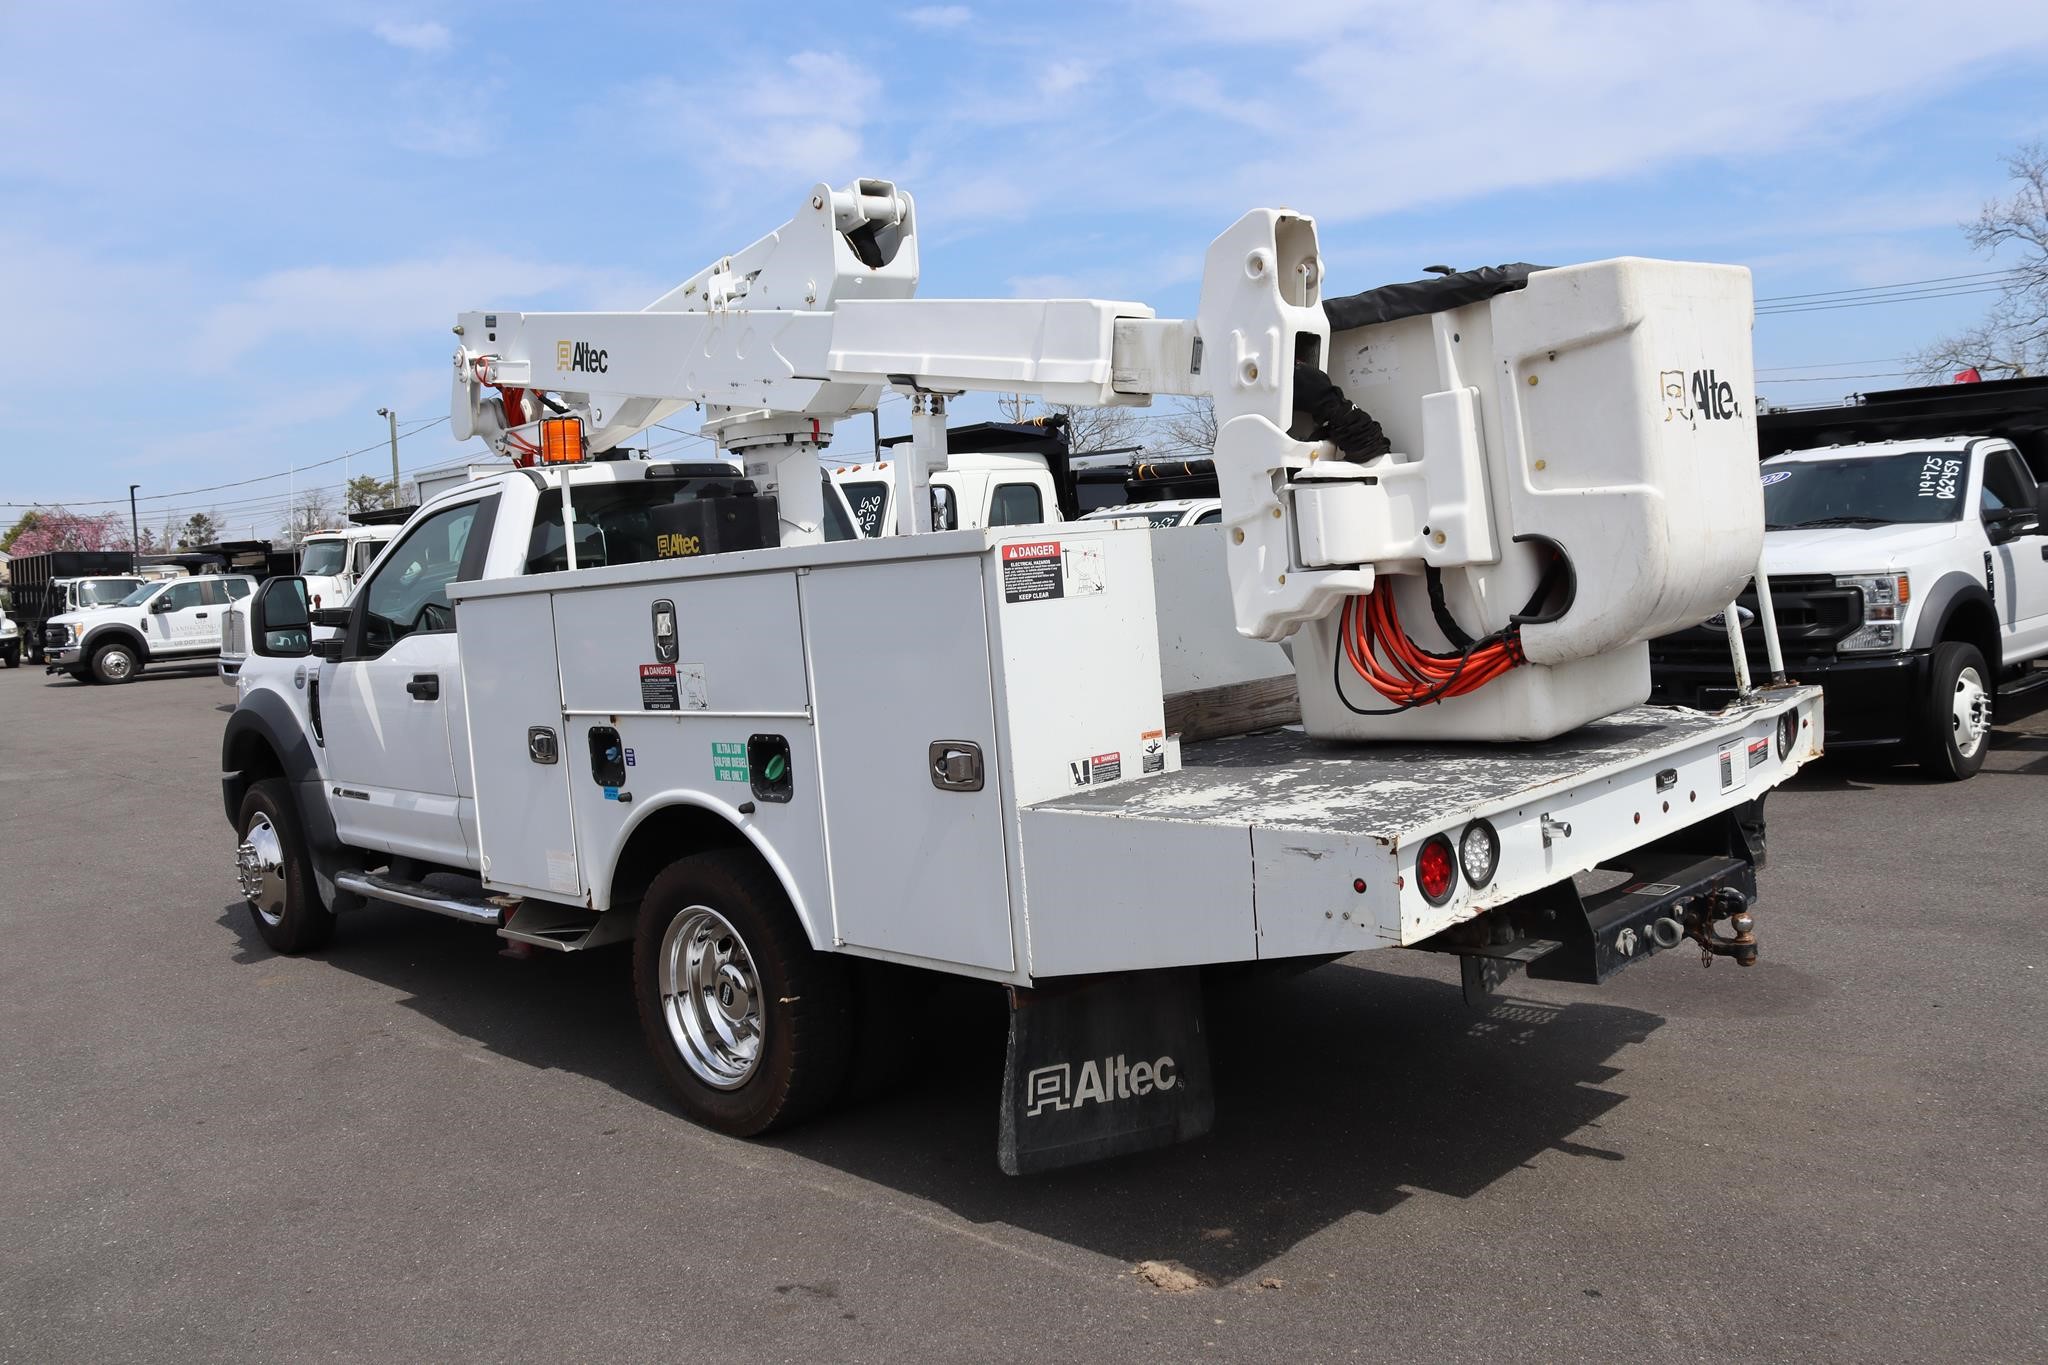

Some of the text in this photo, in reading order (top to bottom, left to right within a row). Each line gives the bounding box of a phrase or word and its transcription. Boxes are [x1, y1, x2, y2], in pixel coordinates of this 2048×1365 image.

[572, 341, 608, 374] Altec
[1691, 368, 1743, 421] Alte
[1917, 455, 1943, 497] 119475
[1936, 460, 1963, 499] 062459
[863, 495, 881, 538] 9526
[670, 533, 700, 557] Altec
[1018, 544, 1055, 558] DANGER
[1032, 591, 1050, 599] CLEAR
[649, 666, 672, 675] DANGER
[716, 743, 742, 755] ULTRA LOW
[1101, 753, 1118, 762] DANGER
[720, 769, 744, 782] FUEL ONLY
[1073, 1053, 1177, 1108] Altec
